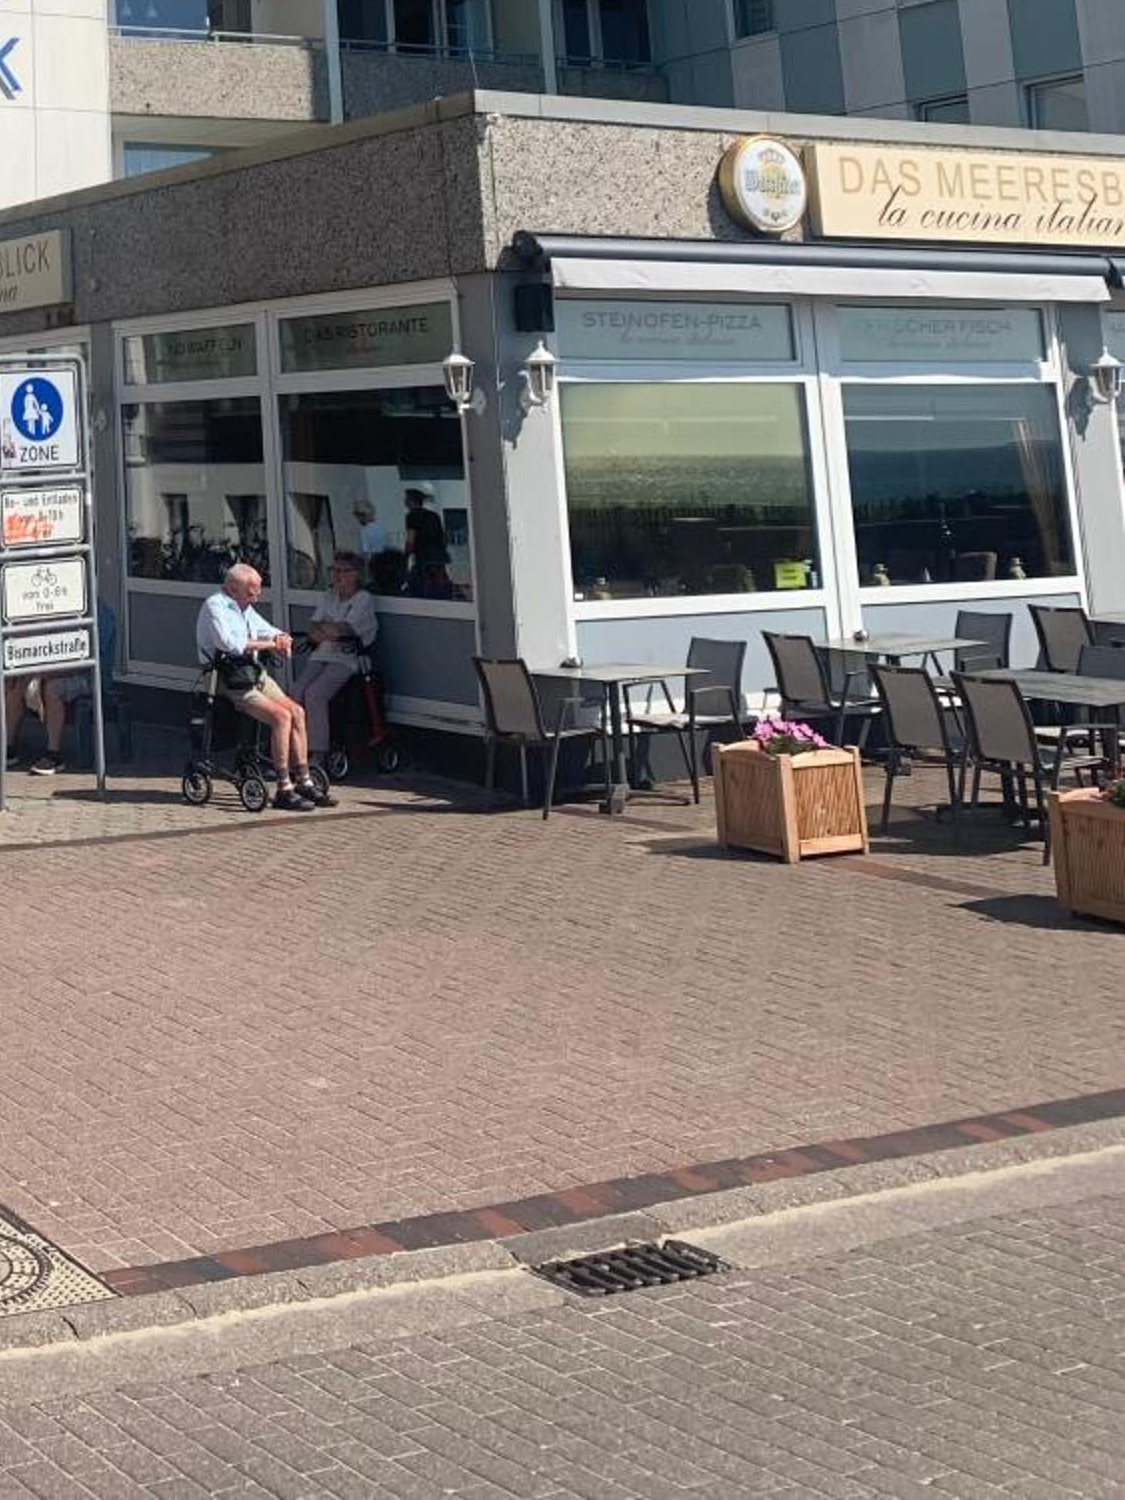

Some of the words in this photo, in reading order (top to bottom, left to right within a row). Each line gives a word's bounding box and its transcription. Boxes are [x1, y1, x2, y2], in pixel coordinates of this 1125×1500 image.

[838, 156, 923, 198] DAS
[935, 161, 1124, 207] MEERESB
[878, 184, 908, 228] la
[920, 203, 1023, 232] cucina
[582, 310, 764, 331] STEINOFEN-PIZZA
[19, 445, 60, 463] ZONE
[6, 636, 87, 662] Bismarckstraße
